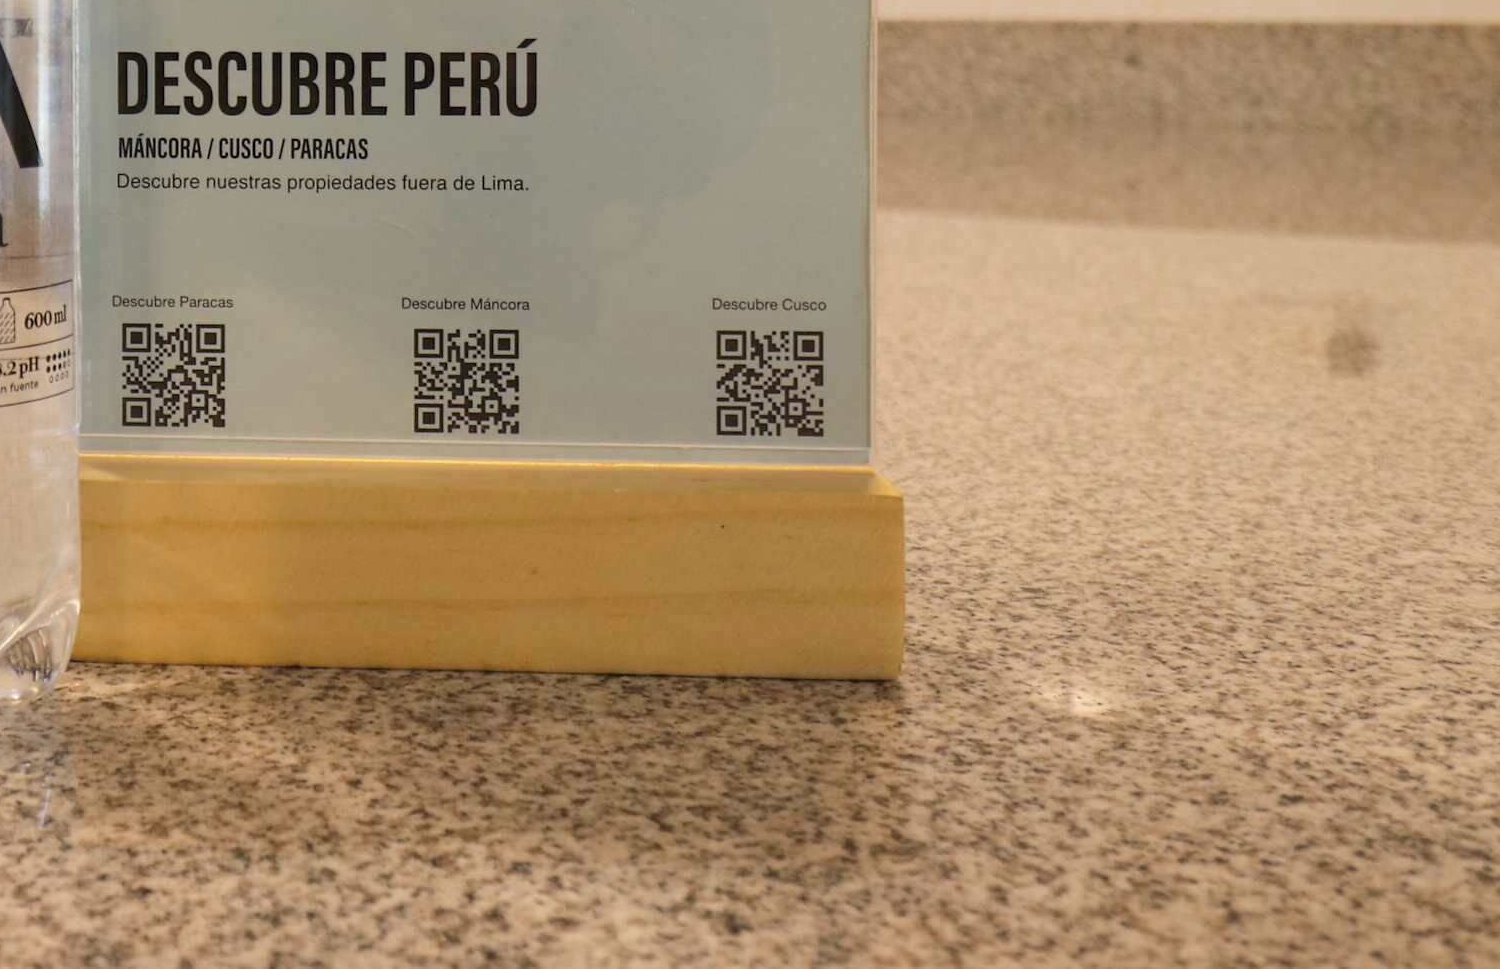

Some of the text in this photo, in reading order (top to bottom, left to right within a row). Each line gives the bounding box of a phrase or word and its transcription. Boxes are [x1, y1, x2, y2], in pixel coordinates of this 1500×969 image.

[117, 39, 539, 117] DESCUBRE PERÚ
[118, 134, 203, 159] MÁNCORA
[219, 138, 275, 160] CUSCO
[290, 138, 369, 160] PARACAS
[116, 173, 529, 195] Descubre nuestras propiedades fuera de Lima.
[112, 294, 234, 308] Descubre Paracas
[401, 295, 530, 311] Descubre Máncora
[712, 297, 827, 312] Descubre Cusco
[24, 305, 67, 329] 600 ml
[19, 356, 40, 379] pH
[10, 380, 39, 392] fuente
